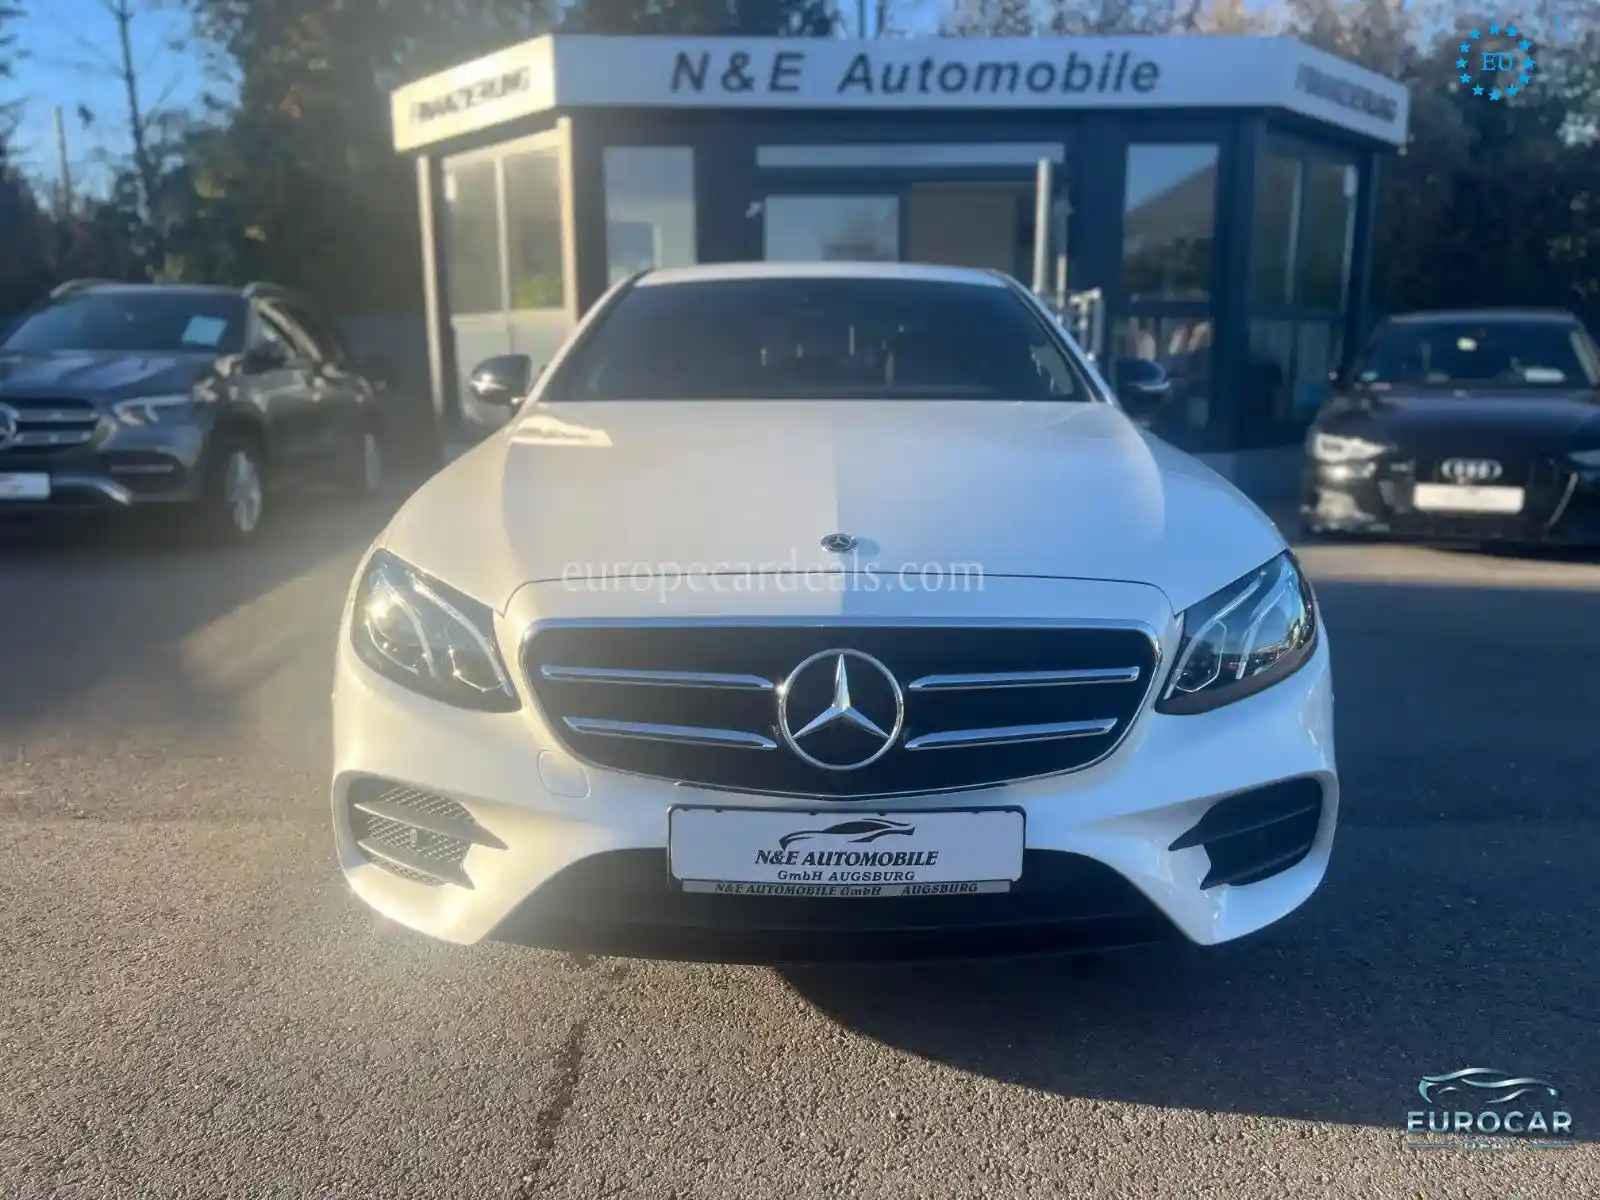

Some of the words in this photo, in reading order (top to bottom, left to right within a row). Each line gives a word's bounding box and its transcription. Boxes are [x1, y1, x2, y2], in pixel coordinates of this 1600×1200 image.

[836, 51, 1160, 95] Automobile
[755, 850, 799, 865] N&E
[801, 851, 939, 867] AUTOMOBILE
[778, 870, 823, 881] GmbH
[827, 871, 915, 882] AUGSBURG
[715, 883, 743, 894] N&E
[748, 884, 837, 896] AUTOMOBILE
[841, 886, 882, 896] GmbH
[902, 883, 979, 895] AUGSBURG
